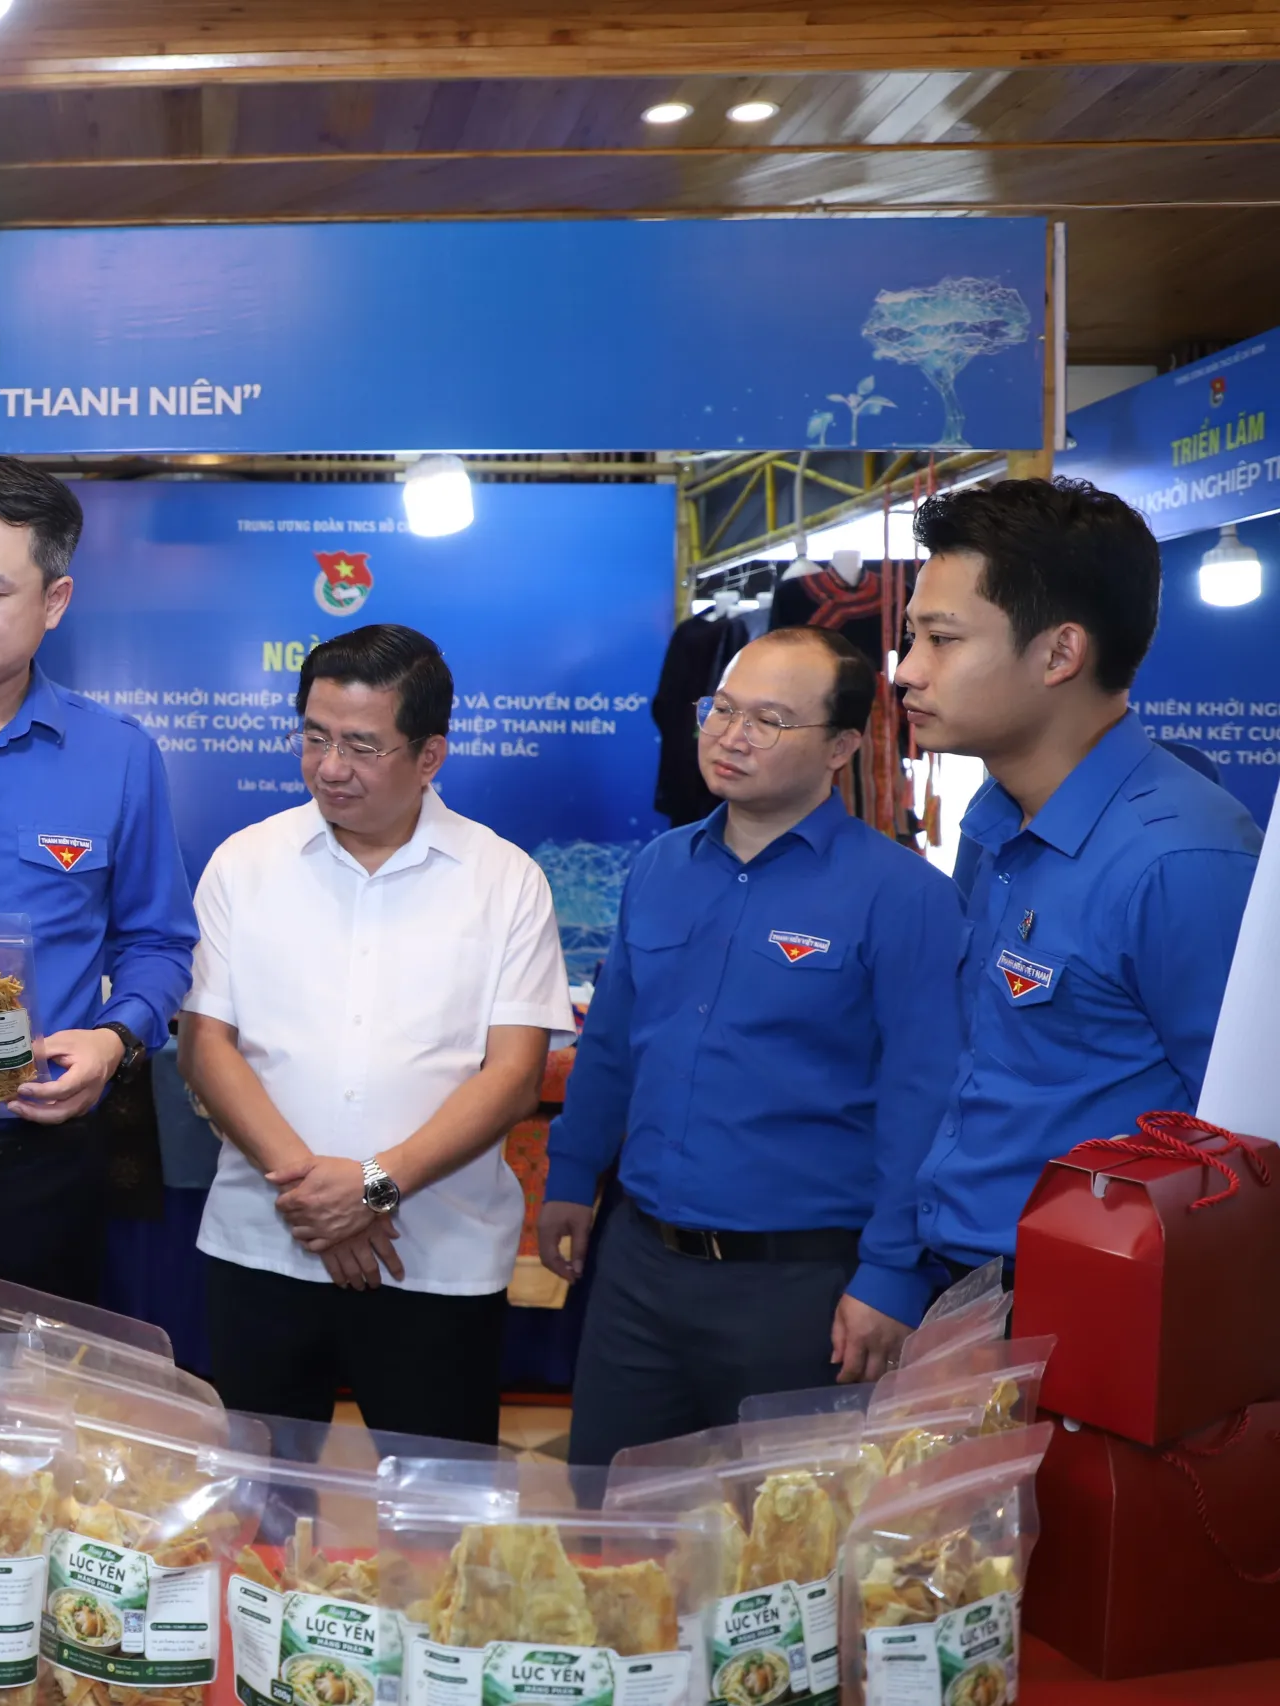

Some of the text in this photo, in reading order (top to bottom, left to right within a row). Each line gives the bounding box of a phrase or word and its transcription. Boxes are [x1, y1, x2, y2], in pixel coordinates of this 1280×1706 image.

[0, 387, 139, 417] THANH
[1171, 411, 1266, 468] TRIỂN LÃM
[1145, 477, 1188, 516] KHỞI
[1191, 460, 1262, 503] NGHIỆP
[237, 520, 275, 532] TRUNG
[347, 520, 376, 532] TNCS
[114, 688, 158, 705] NIÊN
[163, 687, 209, 706] KHỞI
[213, 689, 283, 709] NGHIỆP
[463, 692, 490, 709] VÀ
[1145, 699, 1191, 716] NIÊN
[1196, 697, 1244, 717] KHỞI
[173, 710, 207, 729] KẾT
[212, 713, 265, 733] CUỘC
[269, 715, 299, 730] THI
[501, 719, 566, 733] THANH
[570, 717, 616, 735] NIÊN
[1161, 722, 1202, 740] BÁN
[1207, 721, 1243, 740] KẾT
[157, 736, 197, 752] ÔNG
[201, 737, 253, 752] THÔN
[69, 1553, 95, 1573] LỤC
[306, 1616, 337, 1636] LỤC
[512, 1665, 545, 1684] LỤC
